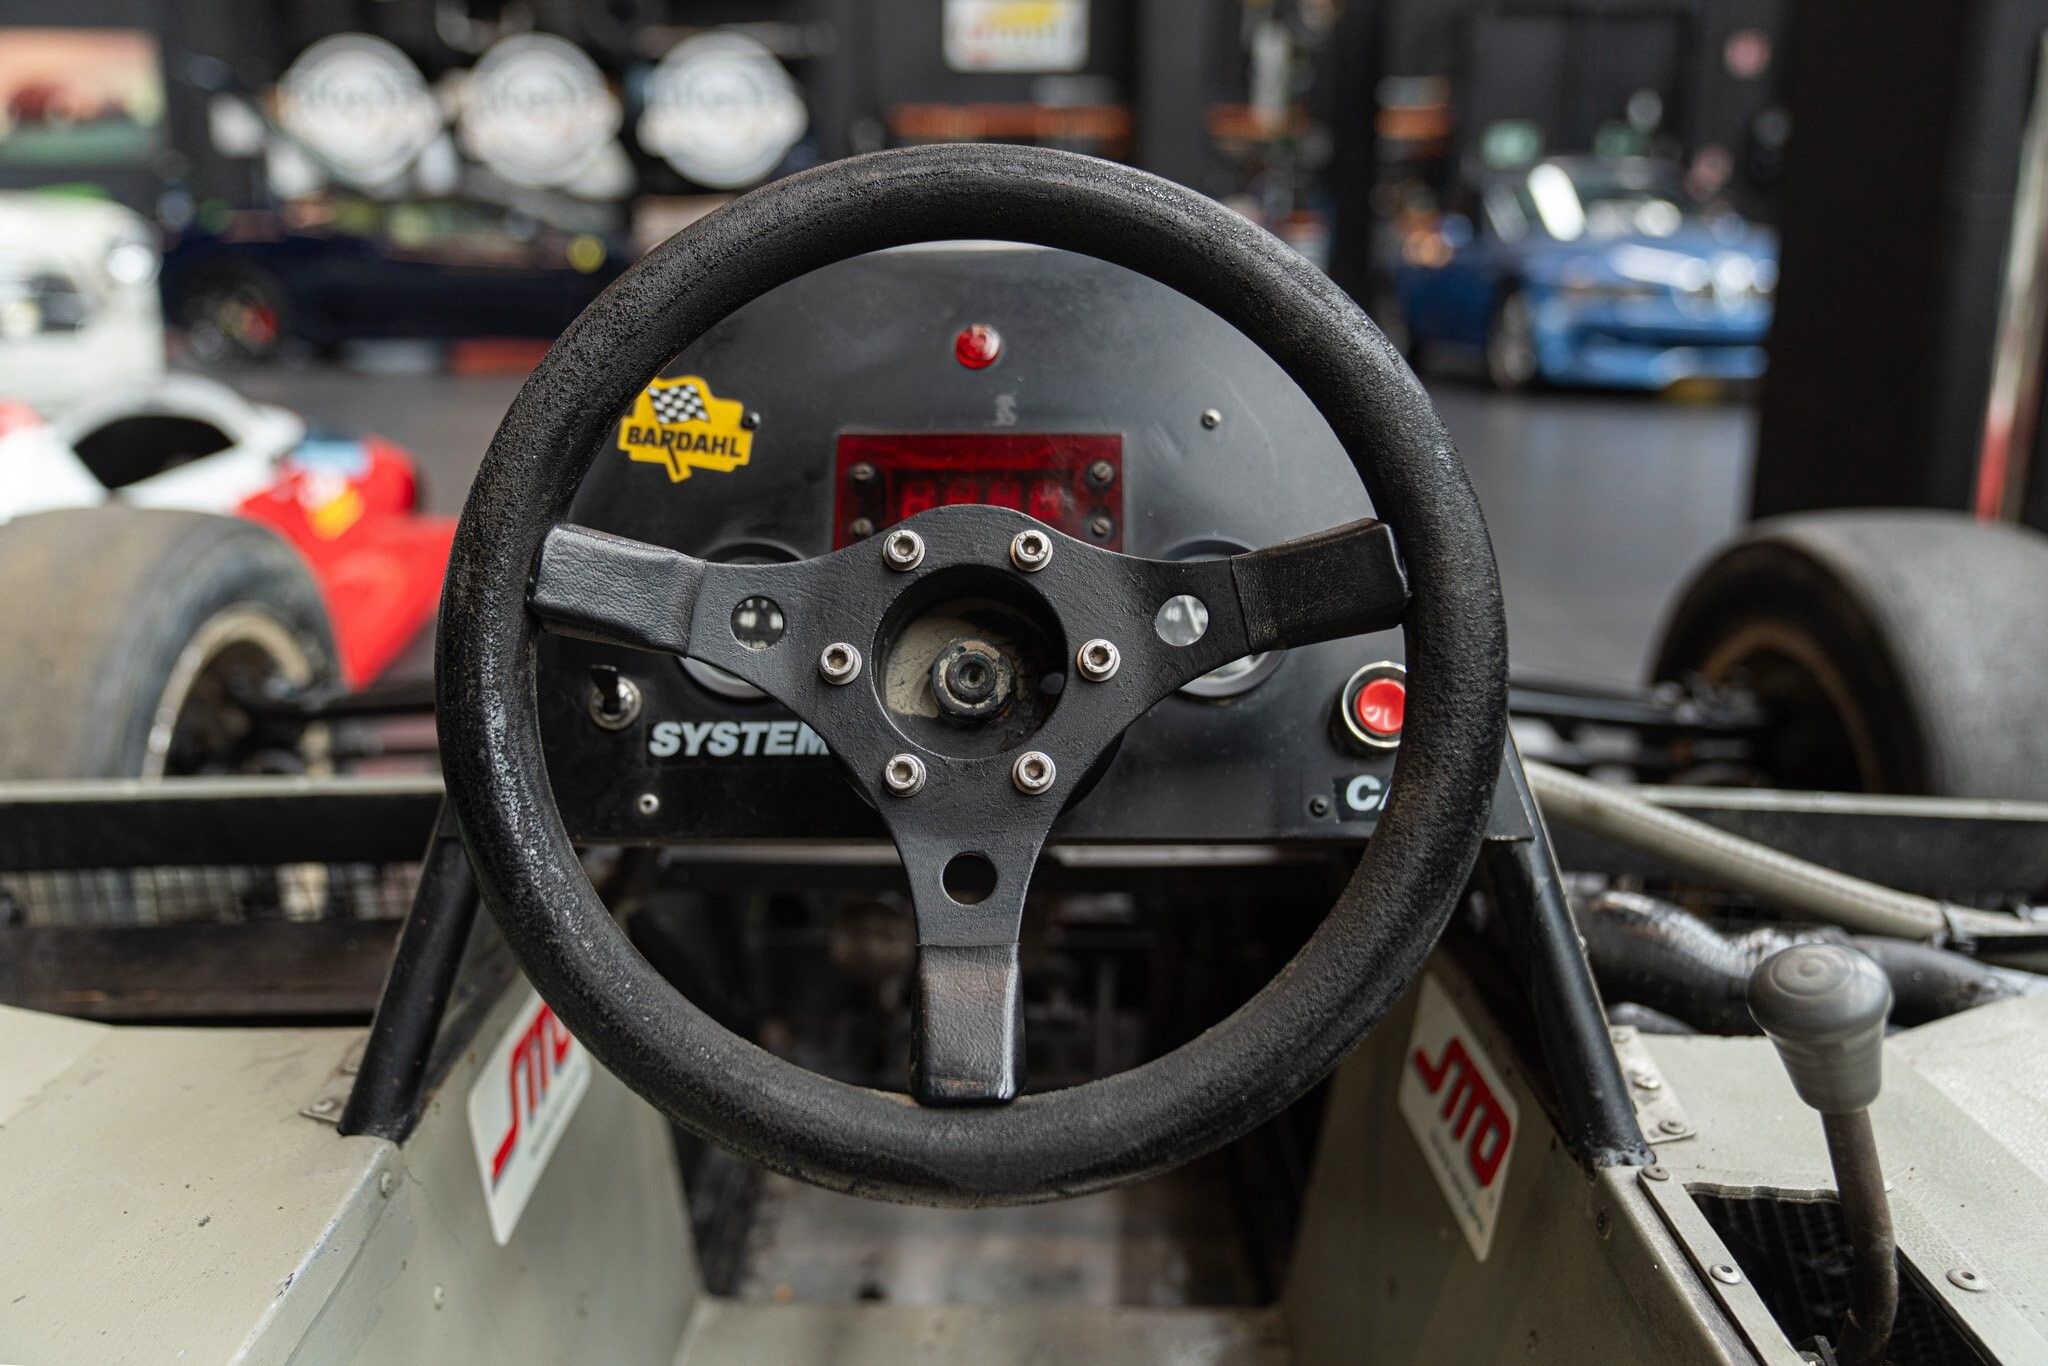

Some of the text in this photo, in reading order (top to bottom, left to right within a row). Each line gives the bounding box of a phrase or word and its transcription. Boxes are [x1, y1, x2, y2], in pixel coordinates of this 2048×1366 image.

[626, 425, 742, 458] BARDAHL
[649, 720, 831, 757] SYSTEM
[1345, 774, 1392, 812] C
